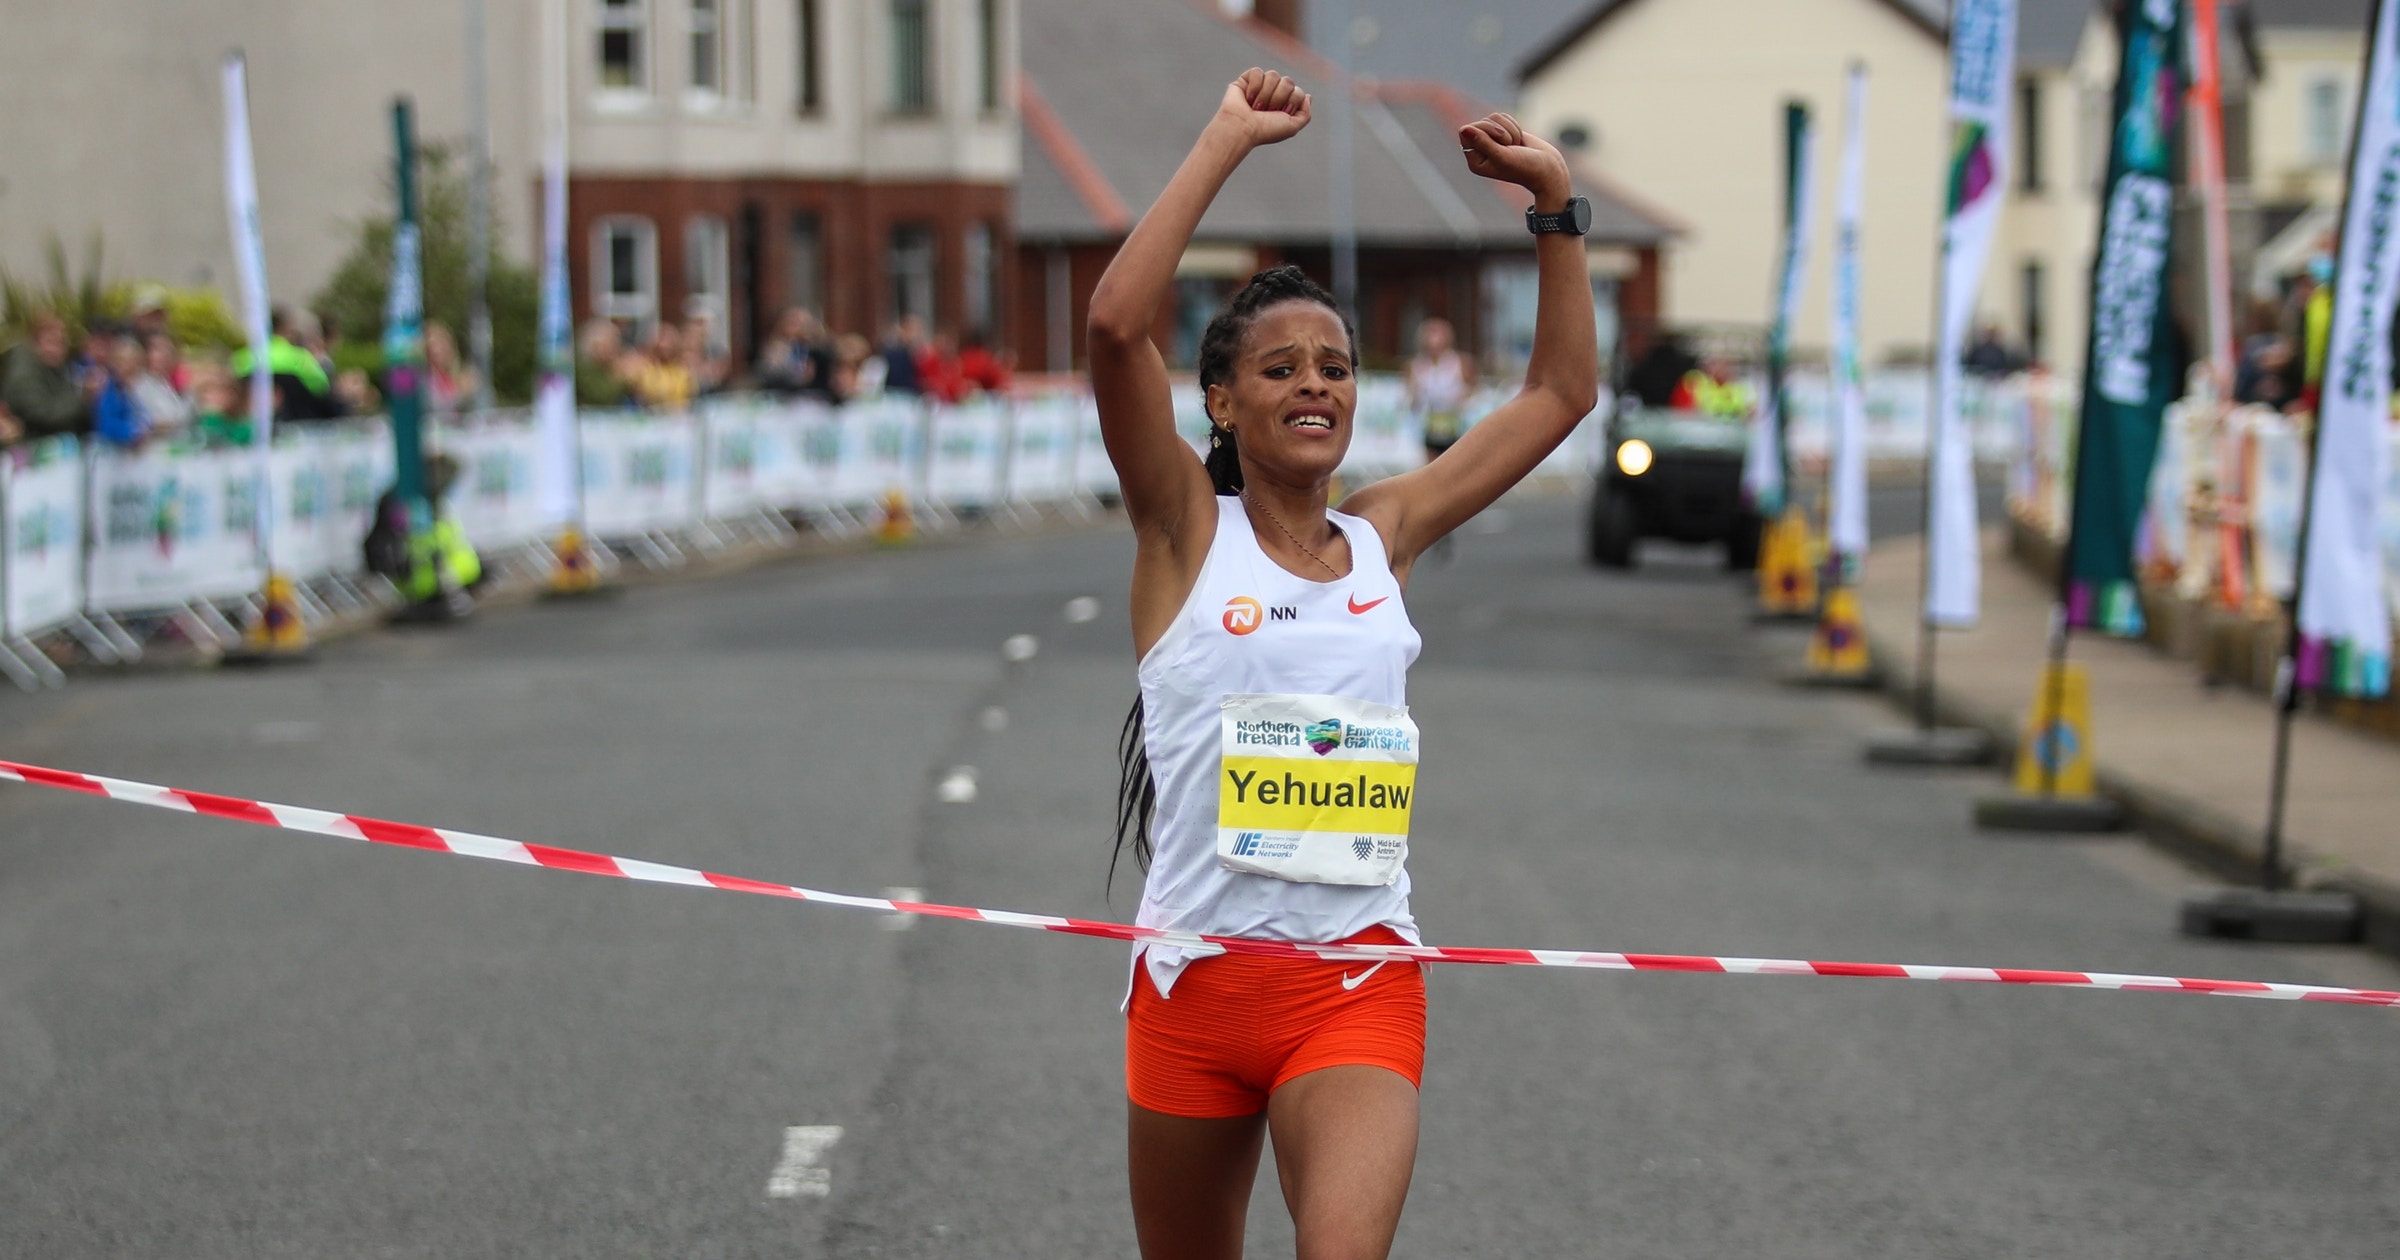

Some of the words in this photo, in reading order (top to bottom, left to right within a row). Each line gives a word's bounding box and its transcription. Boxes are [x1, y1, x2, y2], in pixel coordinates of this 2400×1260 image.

[1270, 606, 1297, 620] NN
[1236, 720, 1301, 733] Northern
[1345, 724, 1396, 737] Embrace
[1236, 732, 1301, 746] Ireland
[1344, 736, 1380, 749] Giant
[1380, 737, 1411, 752] Spirit
[1227, 769, 1411, 810] Yehualaw
[1261, 841, 1299, 850] Electricity
[1257, 850, 1293, 858] Networks
